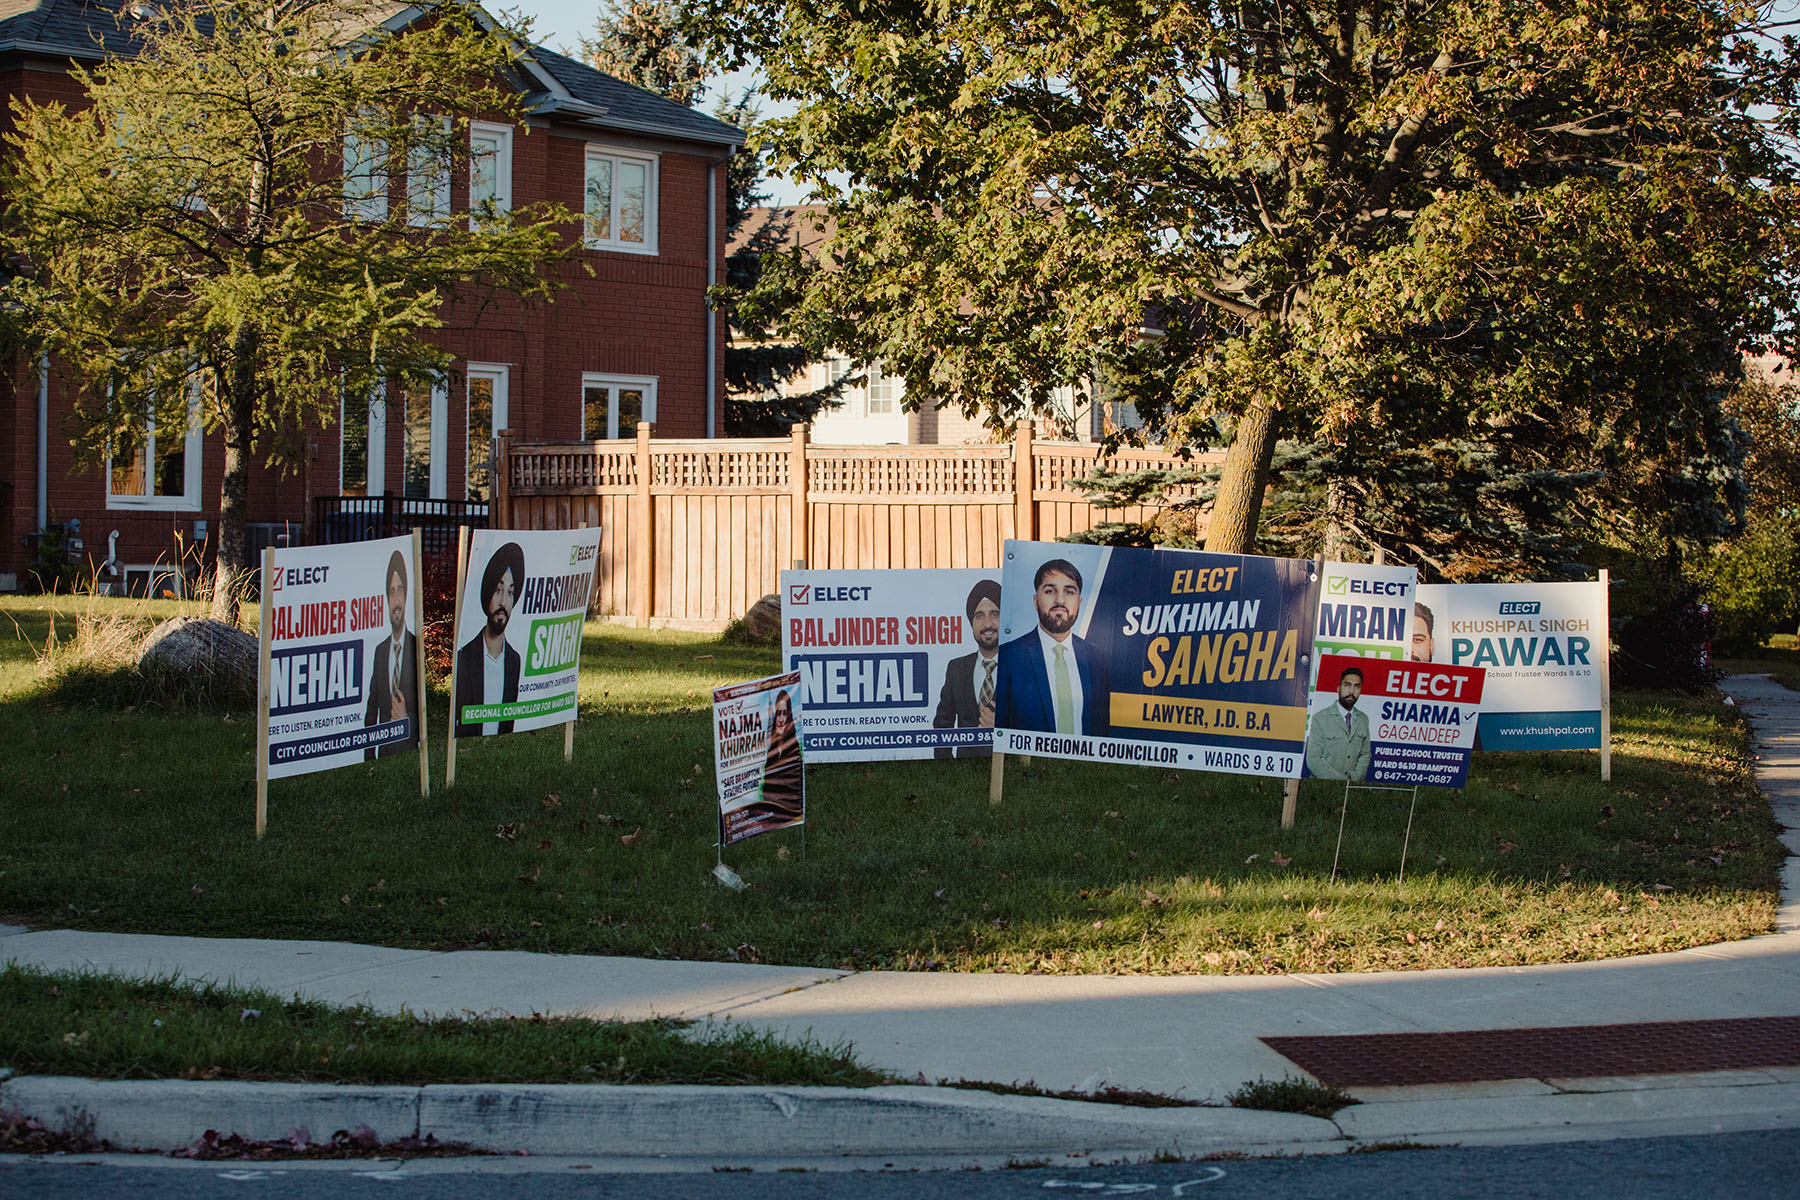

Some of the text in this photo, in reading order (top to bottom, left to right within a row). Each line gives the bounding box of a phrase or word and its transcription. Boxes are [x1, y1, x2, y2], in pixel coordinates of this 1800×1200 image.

[578, 545, 596, 560] ELECT
[286, 566, 329, 586] ELECT
[1171, 567, 1238, 594] ELECT
[1350, 579, 1409, 596] ELECT
[522, 572, 591, 614] HARSIMRAN
[814, 587, 872, 601] ELECT
[350, 595, 384, 632] SINGH
[1123, 600, 1260, 636] SUKHMAN
[1502, 603, 1538, 613] ELECT
[790, 616, 962, 647] BALJINDER SINGH
[1319, 603, 1406, 641] MRAN
[1452, 619, 1589, 633] KHUSHPAL SINGH
[531, 618, 580, 670] SINGH
[1452, 636, 1591, 666] PAWAR
[1142, 629, 1299, 688] SANGHA
[270, 648, 360, 708] NEHAL
[798, 659, 923, 705] NEHAL
[1386, 670, 1468, 698] ELECT
[465, 708, 501, 719] REGIONAL
[503, 703, 540, 716] COUNCILLOR
[541, 701, 551, 712] FOR
[717, 704, 734, 718] VOTE
[828, 717, 858, 726] LISTEN.
[859, 716, 886, 725] READY
[889, 716, 900, 724] TO
[901, 715, 929, 724] WORK.
[1142, 703, 1271, 731] LAWYER, J.D. B.A
[1381, 701, 1460, 726] SHARMA
[269, 726, 280, 736] ERE
[281, 724, 290, 734] TO
[291, 721, 313, 732] LISTEN.
[314, 718, 334, 728] READY
[335, 717, 343, 725] TO
[718, 711, 762, 740] NAJMA
[1378, 724, 1460, 744] GAGANDEEP
[1500, 726, 1595, 737] www.khushpal.com
[276, 746, 297, 758] CITY
[299, 737, 350, 755] COUNCILLOR
[353, 734, 367, 746] FOR
[368, 729, 389, 742] WARD
[719, 730, 766, 761] KHURRAM
[810, 732, 994, 746] CITY COUNCILLOR FOR WARD 9&1
[1009, 734, 1293, 773] FOR REGIONAL COUNCILLOR WARDS 9 & 10
[1374, 760, 1397, 769] WARD
[1417, 763, 1460, 773] BRAMPTON
[1375, 747, 1464, 761] PUBLIC SCHOOL TRUSTEE
[1383, 772, 1452, 784] 647-704-0687
